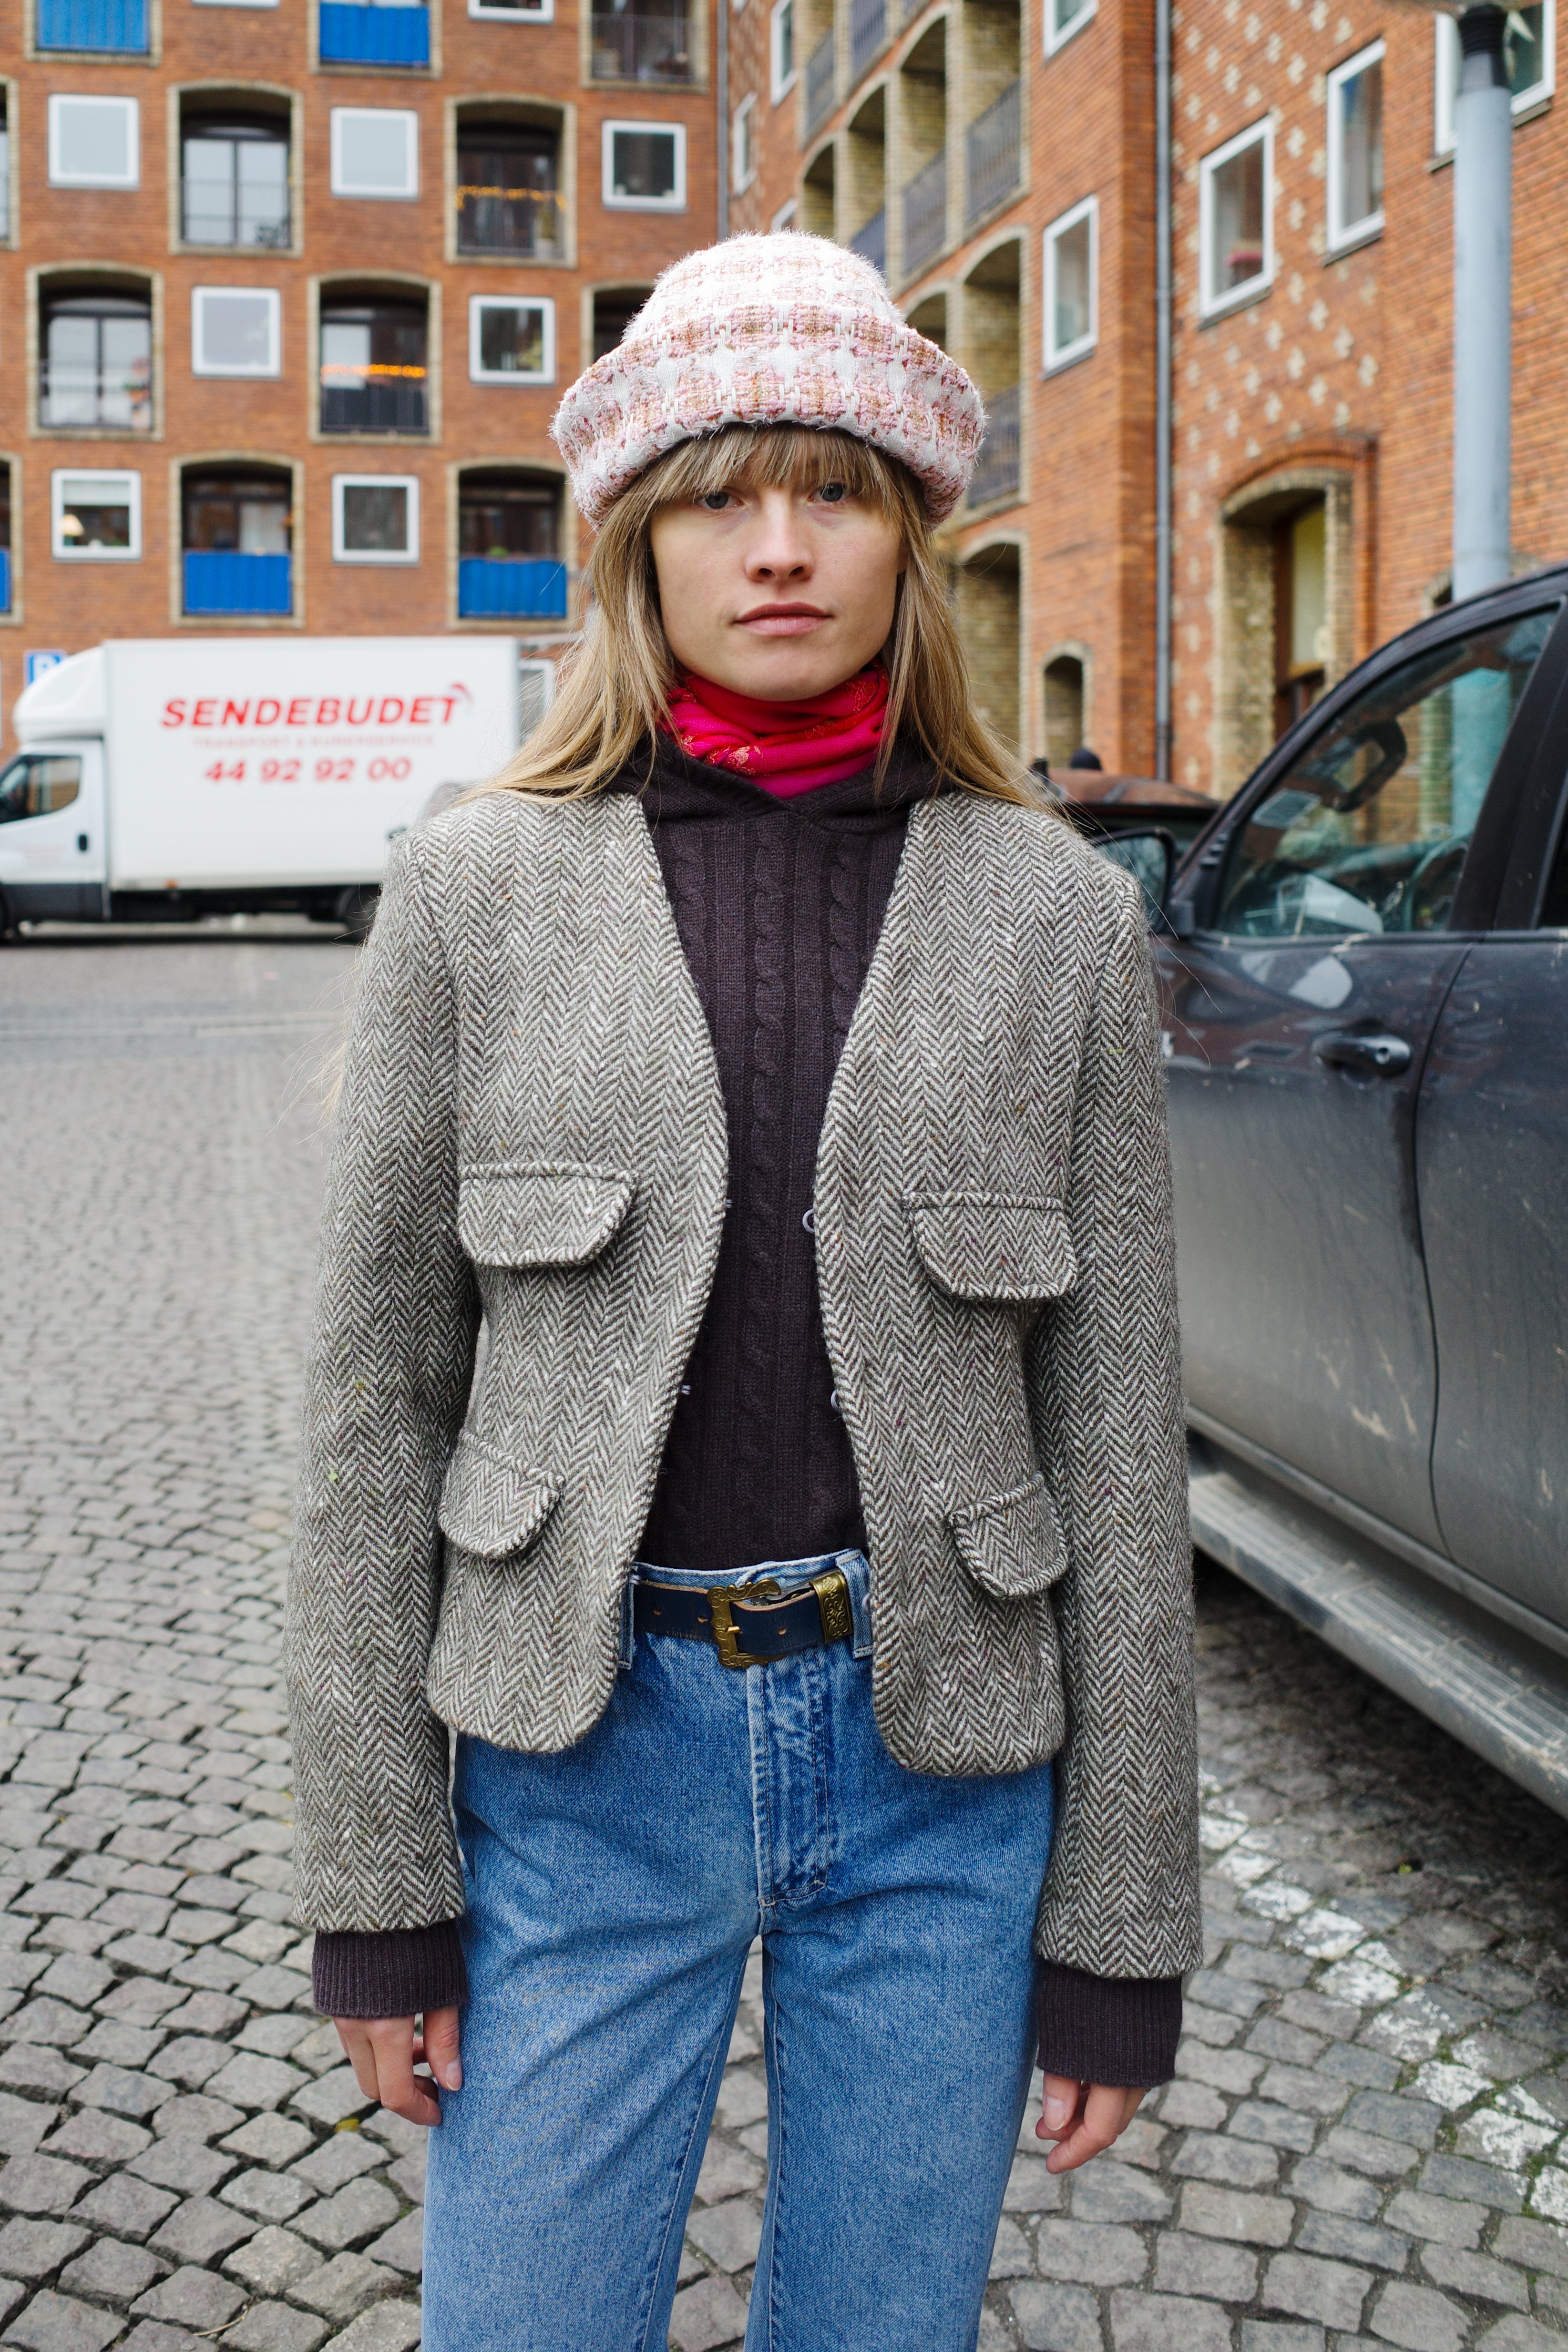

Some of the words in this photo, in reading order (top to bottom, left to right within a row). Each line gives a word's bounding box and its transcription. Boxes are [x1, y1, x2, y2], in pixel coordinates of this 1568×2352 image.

[162, 696, 457, 728] SENDEBUDET
[205, 761, 245, 782] 44
[261, 759, 301, 782] 92
[315, 758, 355, 781] 92
[368, 758, 411, 780] 00
